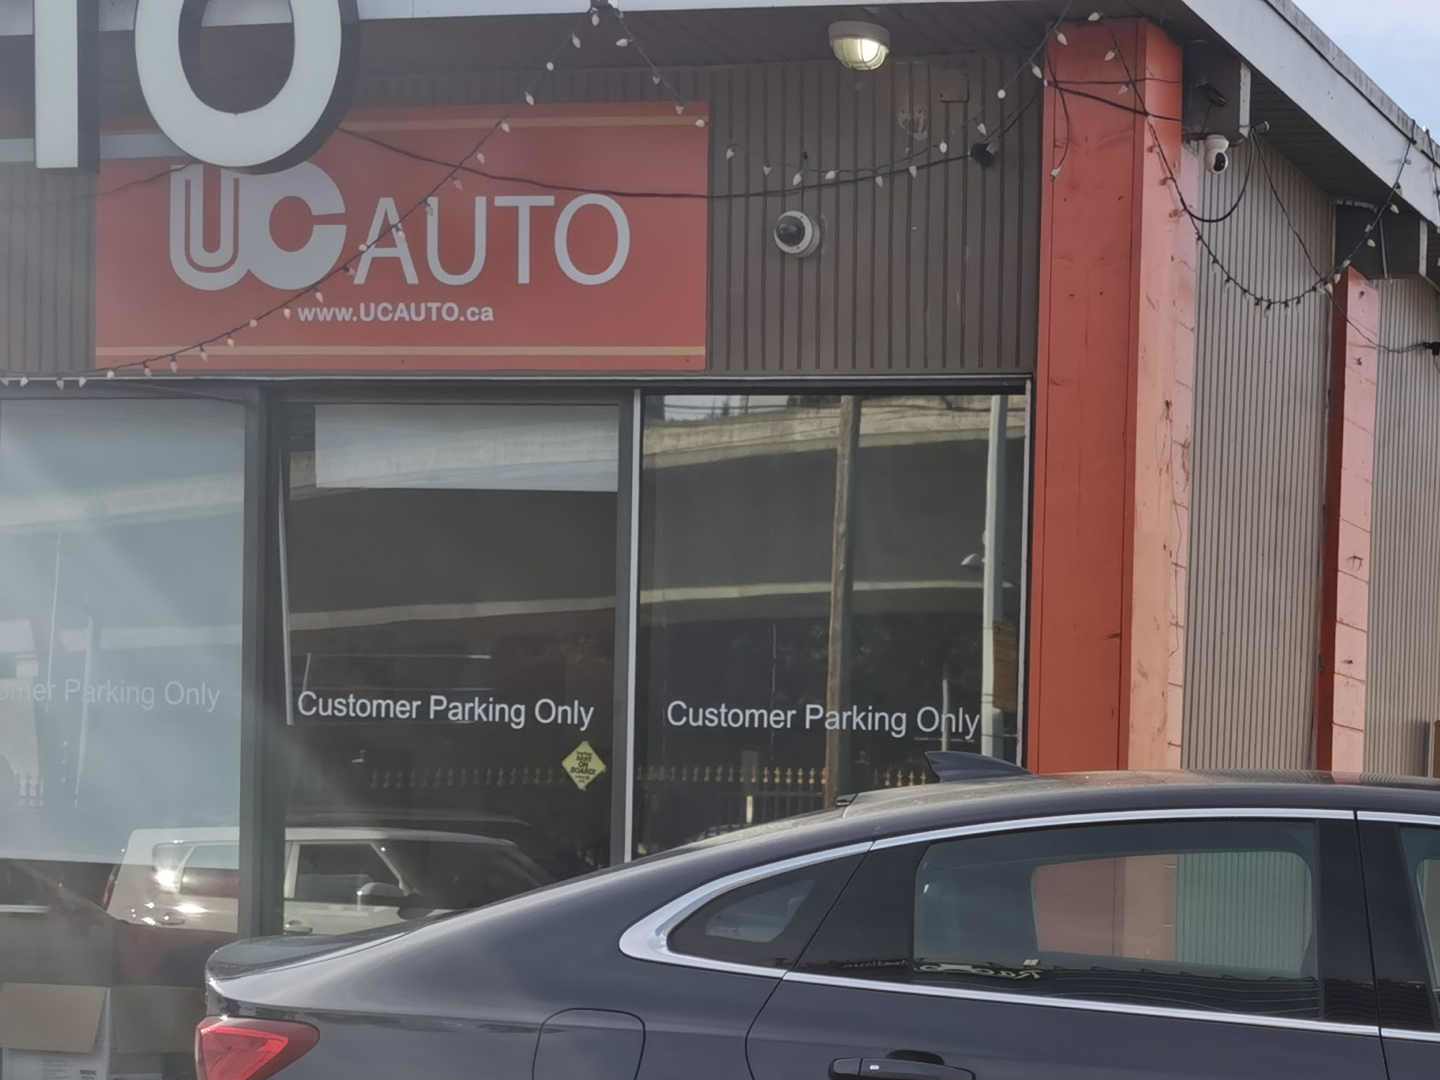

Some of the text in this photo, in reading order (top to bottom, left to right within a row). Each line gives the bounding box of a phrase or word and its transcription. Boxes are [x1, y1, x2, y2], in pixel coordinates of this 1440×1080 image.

[297, 302, 494, 324] www.UCAUTO.ca
[64, 678, 154, 711] Parking
[164, 680, 221, 713] Only
[297, 691, 594, 731] Customer Parking Only
[667, 700, 980, 740] Customer Parking Only
